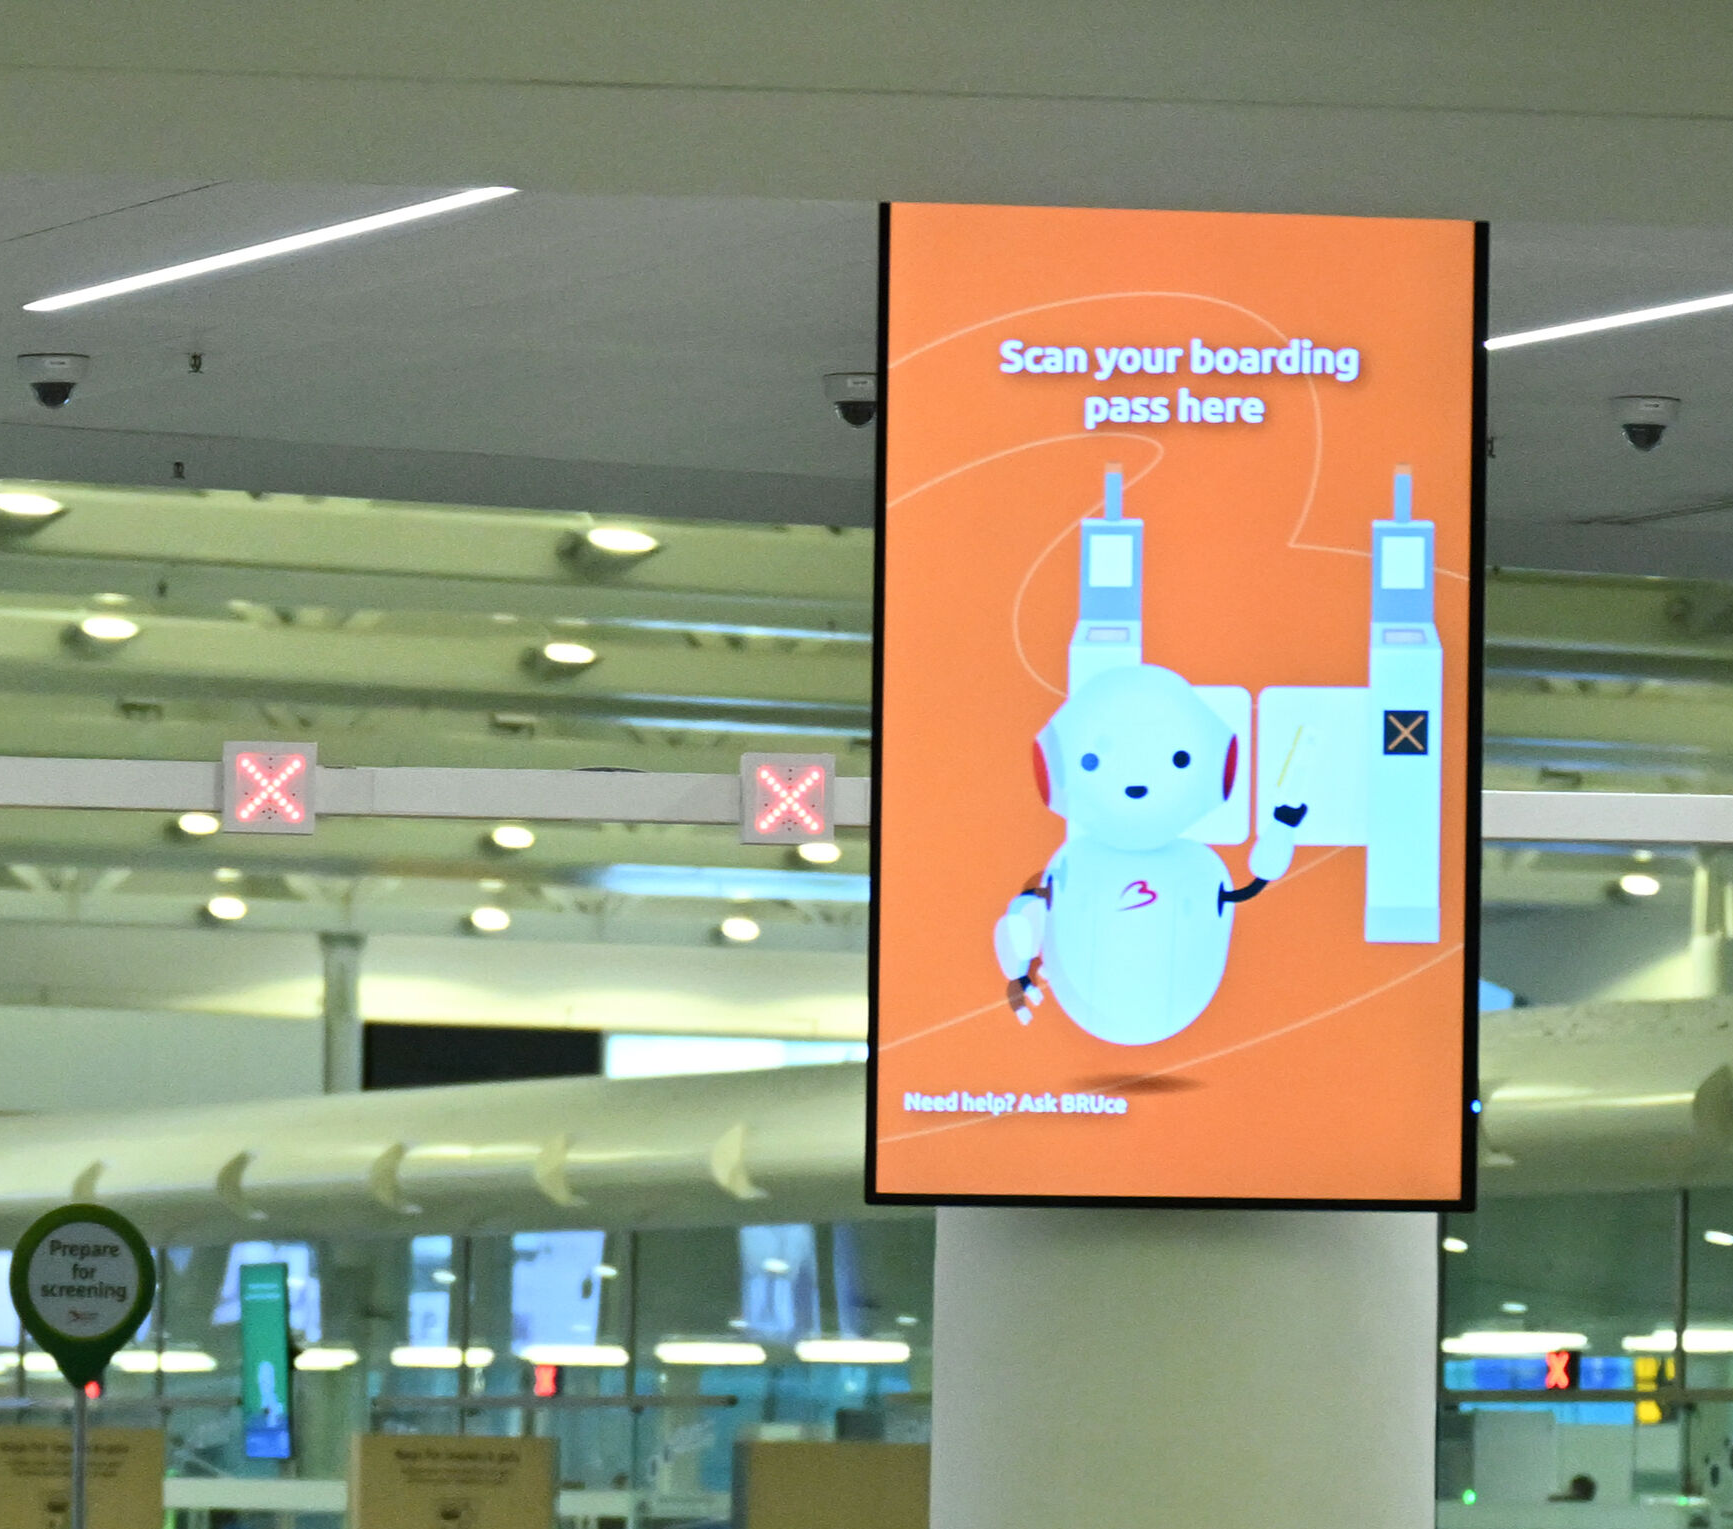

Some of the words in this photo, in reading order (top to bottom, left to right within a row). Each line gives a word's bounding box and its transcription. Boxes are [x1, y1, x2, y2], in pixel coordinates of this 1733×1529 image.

[999, 338, 1088, 374] Scan
[1093, 346, 1184, 381] your
[1189, 337, 1360, 382] boarding
[1084, 395, 1171, 430] pass
[1177, 386, 1266, 423] here
[903, 1091, 959, 1112] Need
[961, 1090, 1016, 1116] help?
[1018, 1092, 1058, 1113] Ask
[1060, 1093, 1128, 1115] BRUce
[49, 1239, 120, 1261] Prepare
[72, 1263, 96, 1280] for
[41, 1281, 127, 1302] screening
